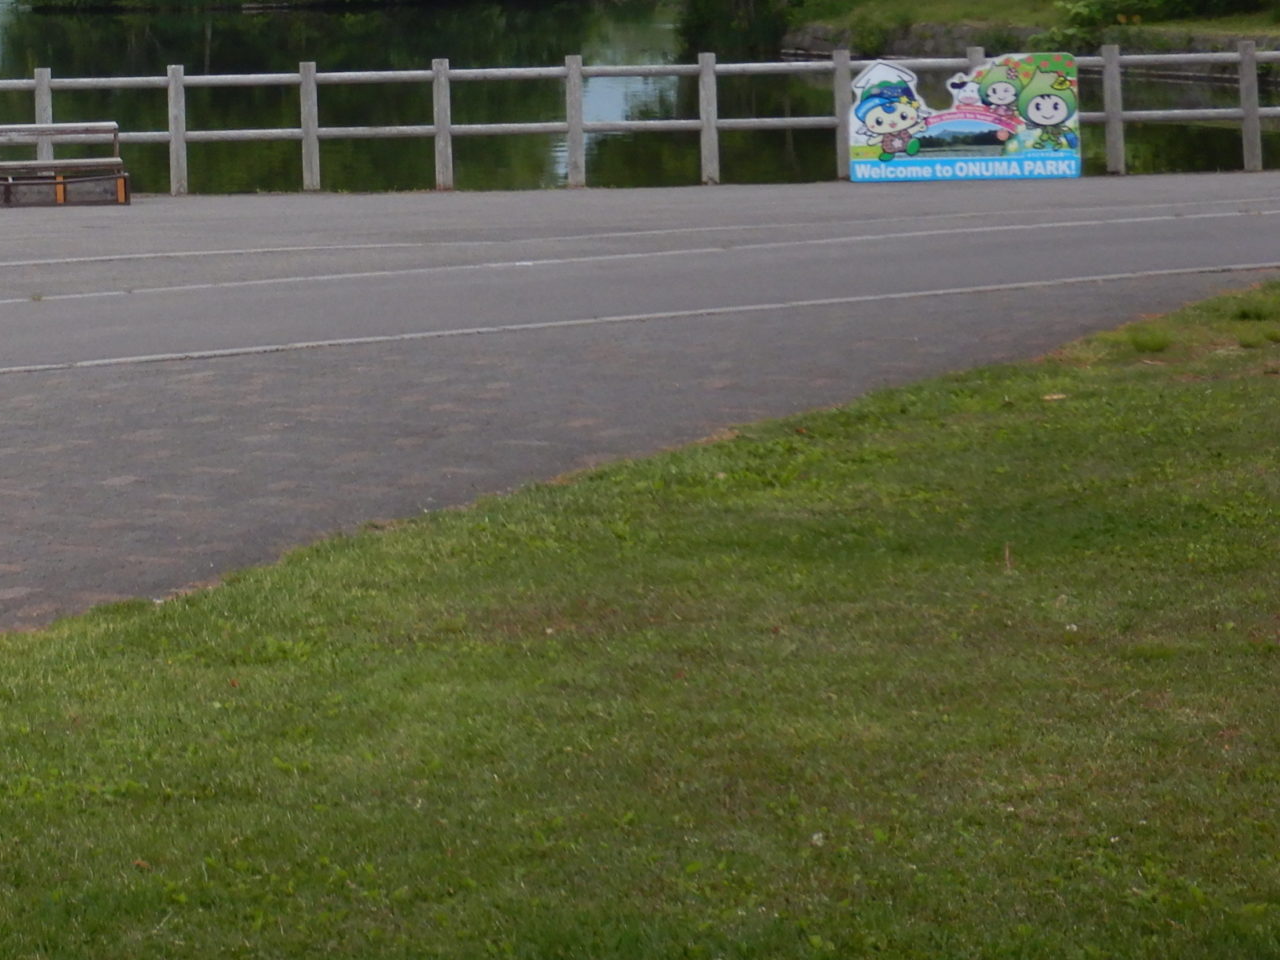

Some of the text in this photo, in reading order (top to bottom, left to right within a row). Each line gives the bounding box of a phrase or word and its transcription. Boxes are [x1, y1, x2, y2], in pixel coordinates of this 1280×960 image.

[854, 159, 1077, 178] Welcome to ONUMA PARK!
